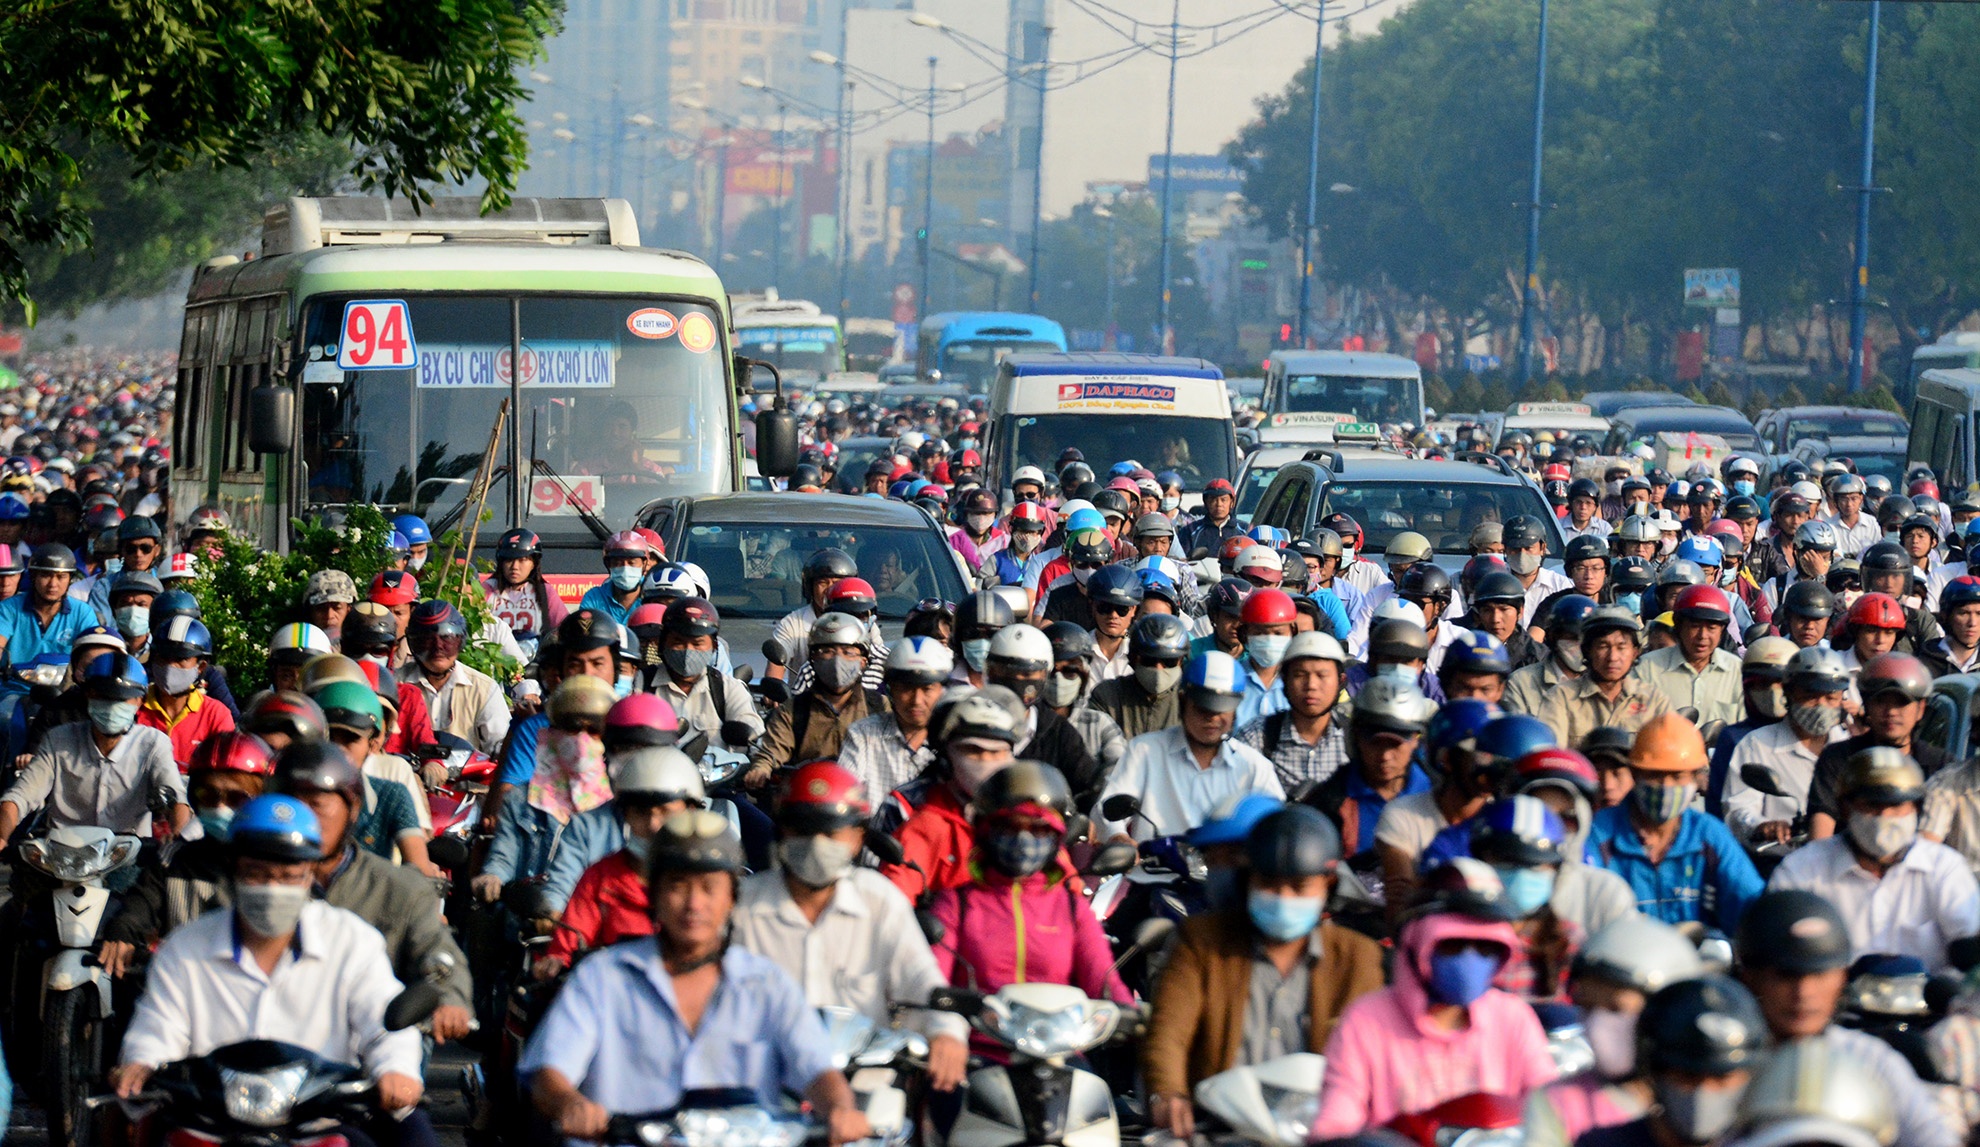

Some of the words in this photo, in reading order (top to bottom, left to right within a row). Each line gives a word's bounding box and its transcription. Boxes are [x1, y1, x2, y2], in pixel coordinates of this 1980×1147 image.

[347, 306, 407, 365] 94
[421, 351, 442, 385] BX
[469, 351, 494, 384] CHI
[501, 351, 533, 378] 94
[539, 351, 554, 383] BX
[556, 346, 582, 385] CHỢ
[585, 344, 609, 384] LỚN
[1086, 385, 1174, 399] DAPHACO
[1058, 401, 1084, 410] 100%
[1293, 414, 1336, 424] VINASUN
[1340, 423, 1375, 433] TAXI
[533, 480, 597, 513] 94
[557, 584, 578, 597] GIAO
[495, 597, 536, 611] PYEX
